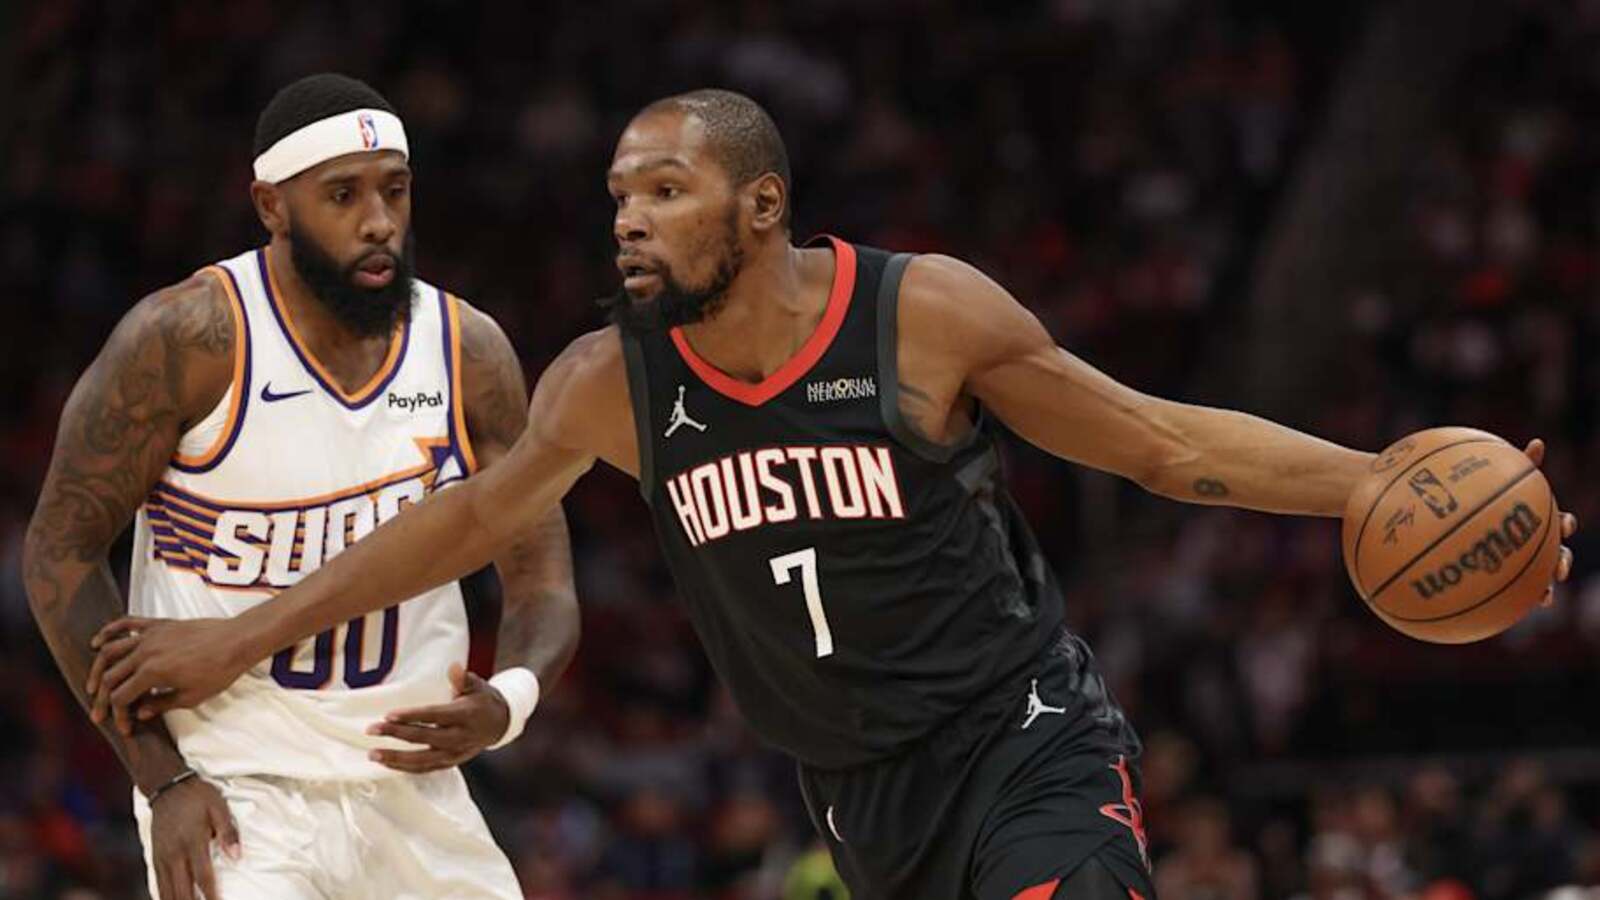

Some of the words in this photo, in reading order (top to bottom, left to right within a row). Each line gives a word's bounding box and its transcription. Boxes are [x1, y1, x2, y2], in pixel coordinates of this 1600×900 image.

[388, 390, 443, 413] PayPal
[206, 478, 425, 588] SUN
[666, 445, 905, 547] HOUSTON
[1410, 503, 1542, 598] Wilson
[768, 547, 834, 659] 7
